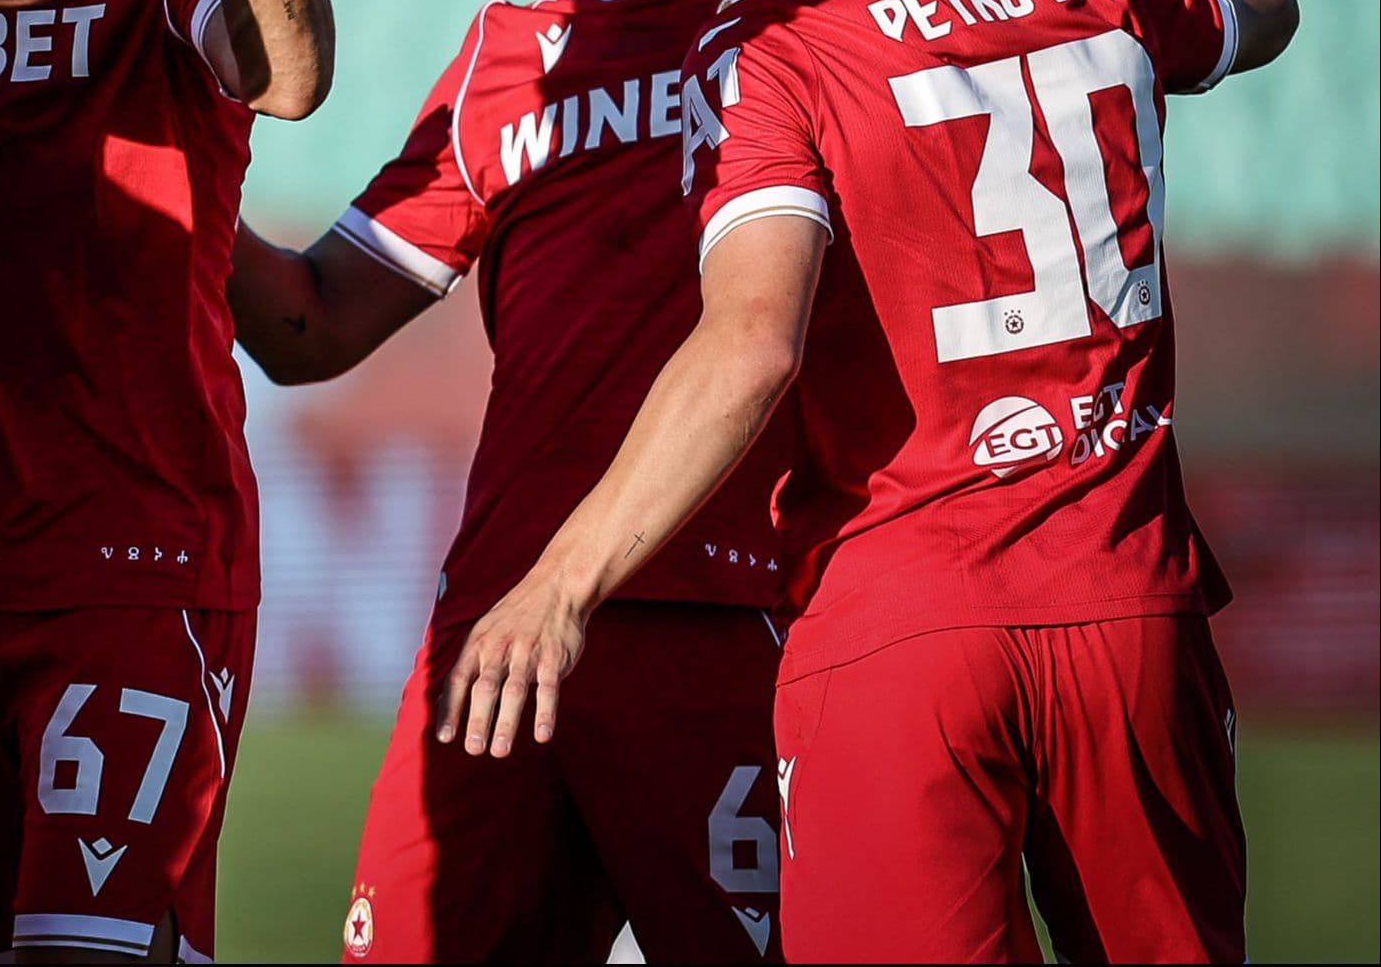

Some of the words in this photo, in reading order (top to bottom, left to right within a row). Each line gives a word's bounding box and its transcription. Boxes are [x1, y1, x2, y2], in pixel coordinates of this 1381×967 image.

[888, 28, 1164, 364] 30
[984, 424, 1060, 459] EGT
[37, 683, 191, 825] 67
[708, 765, 779, 894] 6
